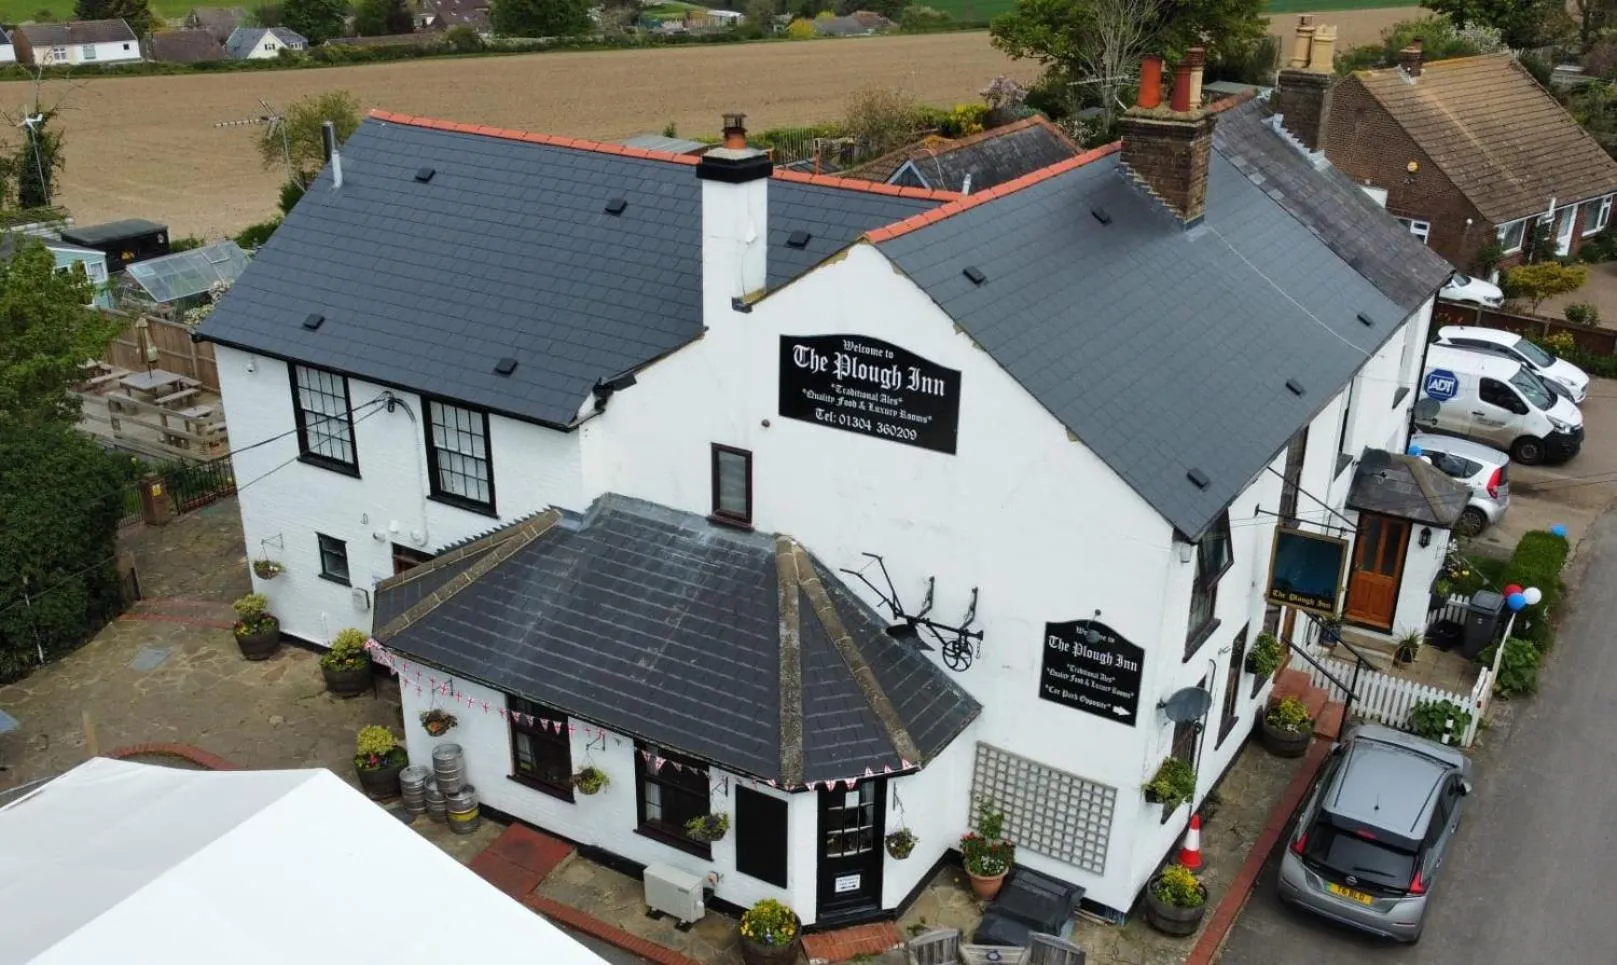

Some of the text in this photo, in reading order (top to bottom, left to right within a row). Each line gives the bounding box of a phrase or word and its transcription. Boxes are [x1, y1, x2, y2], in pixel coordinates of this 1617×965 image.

[843, 339, 894, 359] Welcome to
[793, 345, 945, 396] The Plough Inn
[1429, 378, 1454, 393] ADT
[836, 396, 857, 408] Food
[859, 402, 866, 410] &
[869, 403, 898, 417] Luxury
[815, 408, 917, 440] Tel: 01304 360209
[1272, 589, 1331, 608] The Plough Inn
[1048, 635, 1138, 672] The Plough Inn
